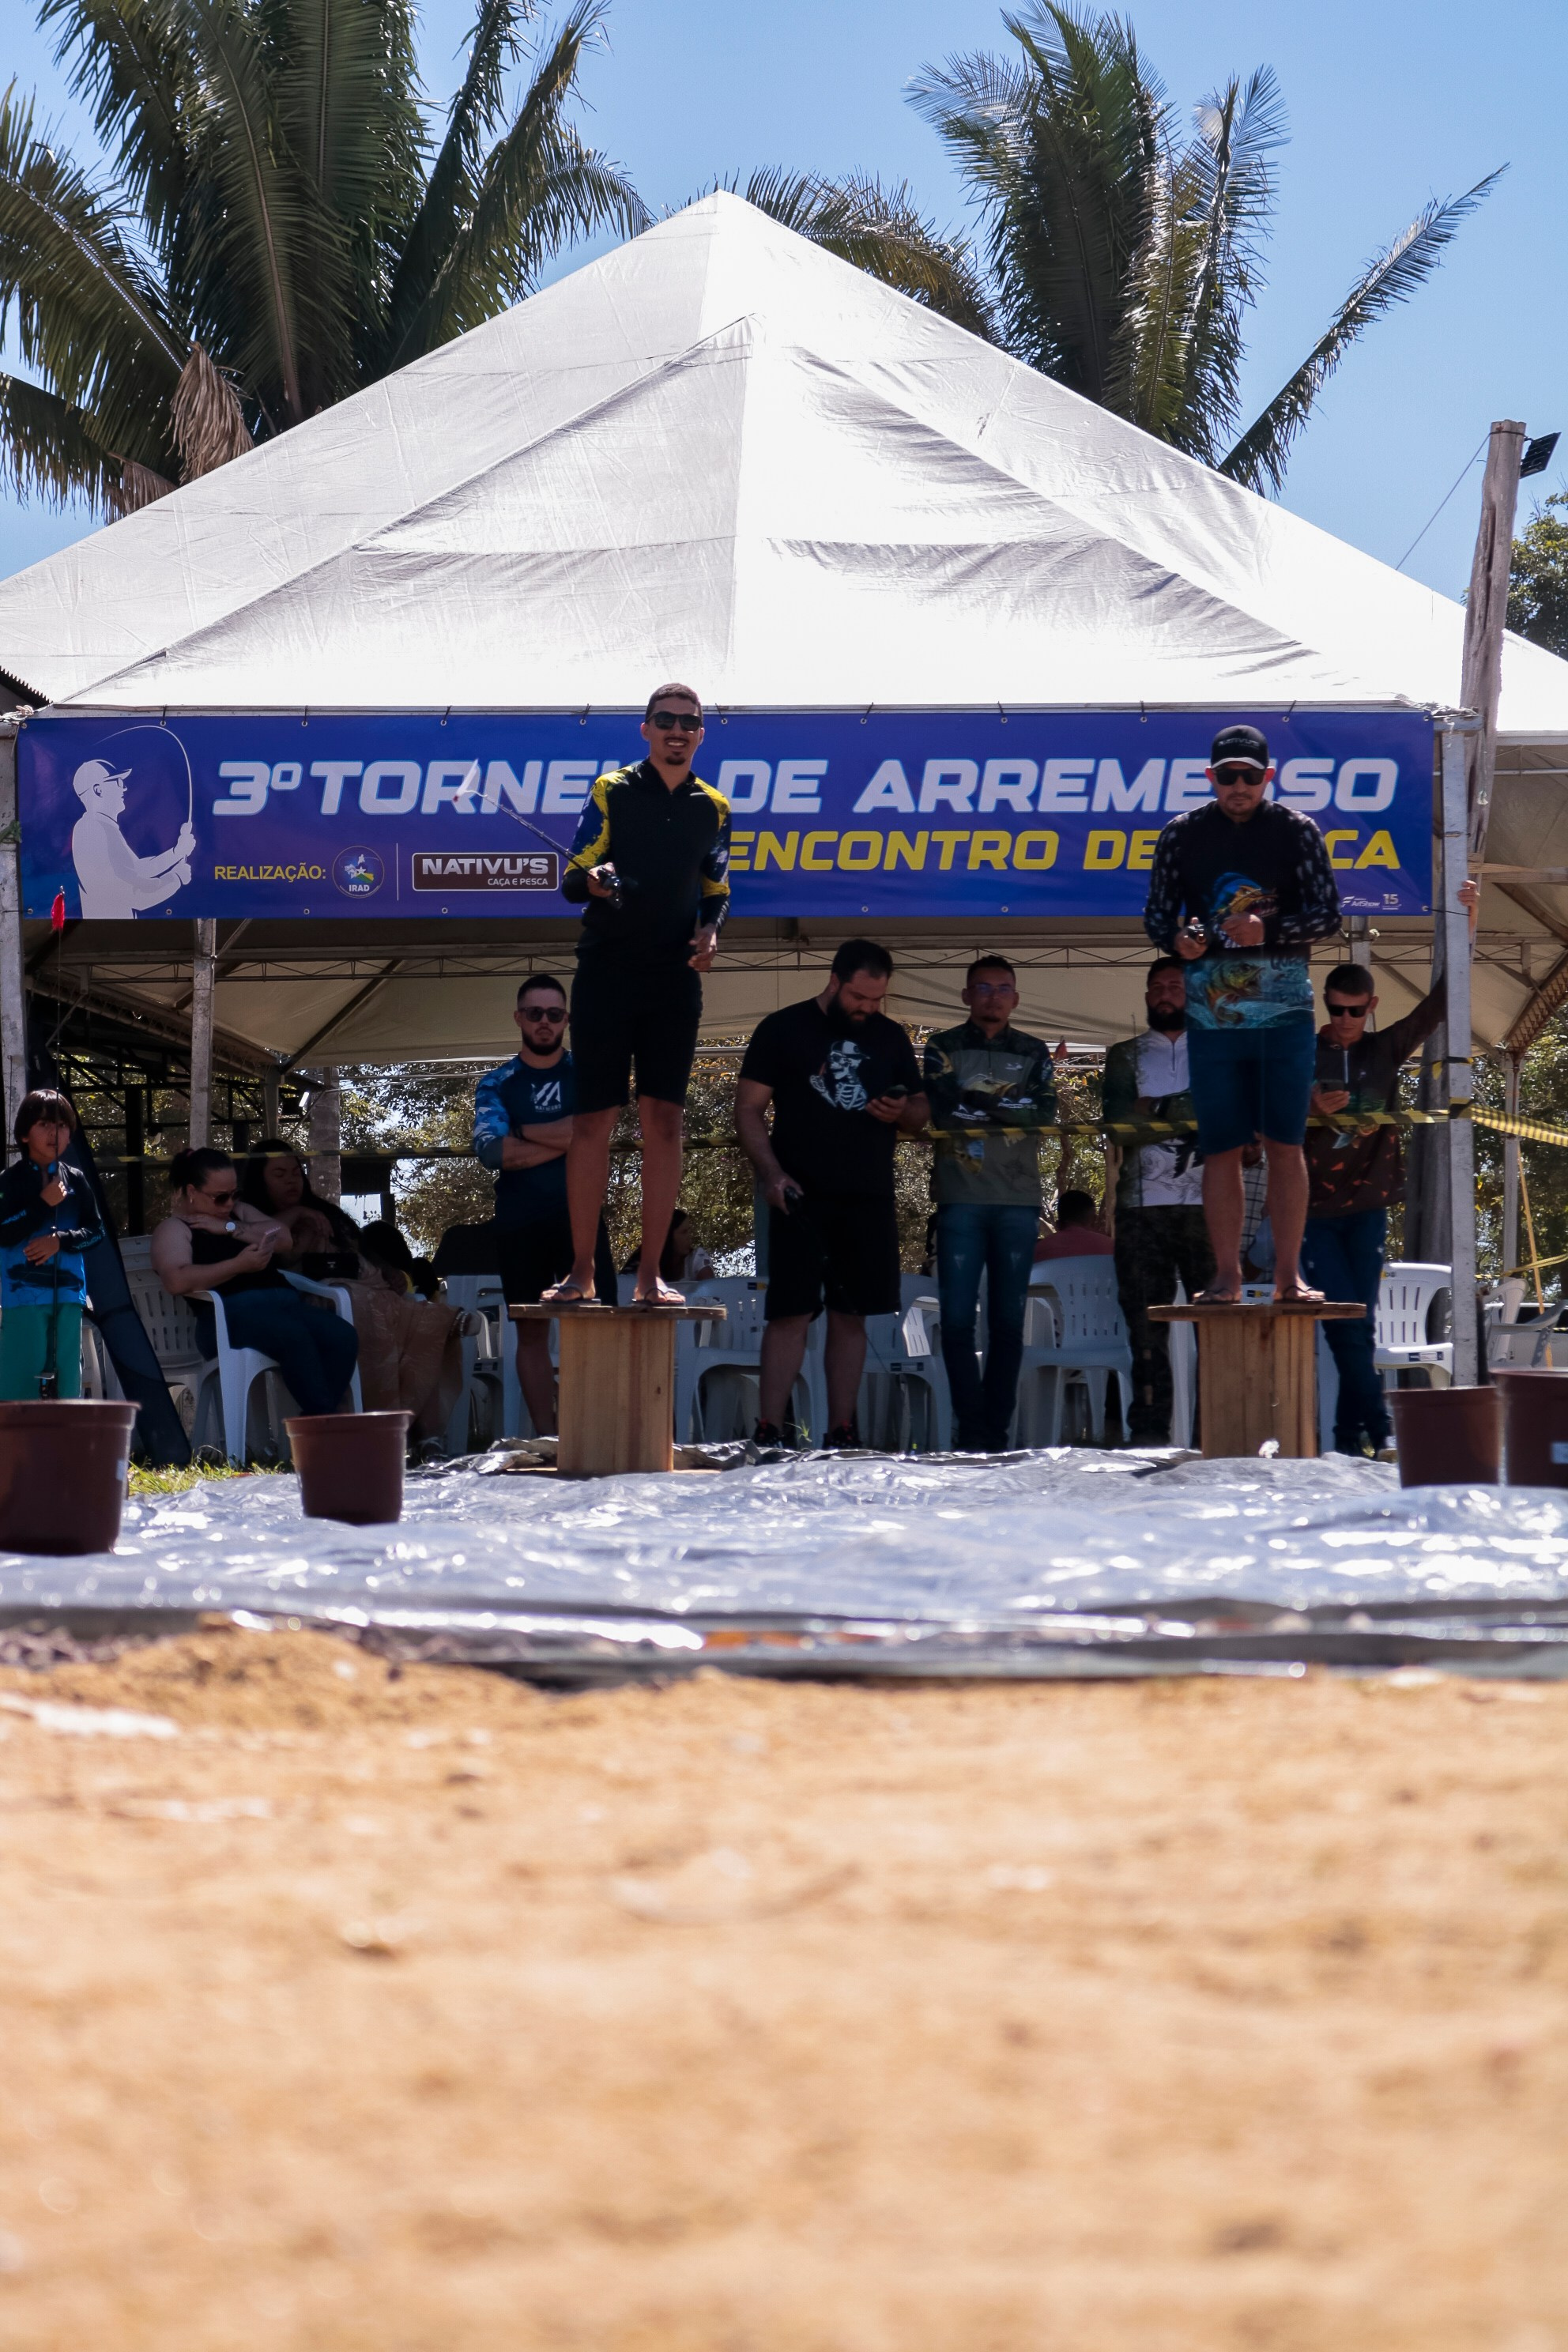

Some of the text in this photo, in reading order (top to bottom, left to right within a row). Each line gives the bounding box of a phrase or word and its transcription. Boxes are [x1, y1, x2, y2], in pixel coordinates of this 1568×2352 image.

[212, 758, 1399, 815] 3º TORNE DE ARREMESO
[728, 830, 1163, 871] ENCONTRO DE
[213, 861, 326, 883] REALIZAÇÃO:
[422, 858, 548, 875] NATIVU'S
[487, 877, 548, 887] CAÇA E PESCA
[1383, 893, 1399, 905] 15
